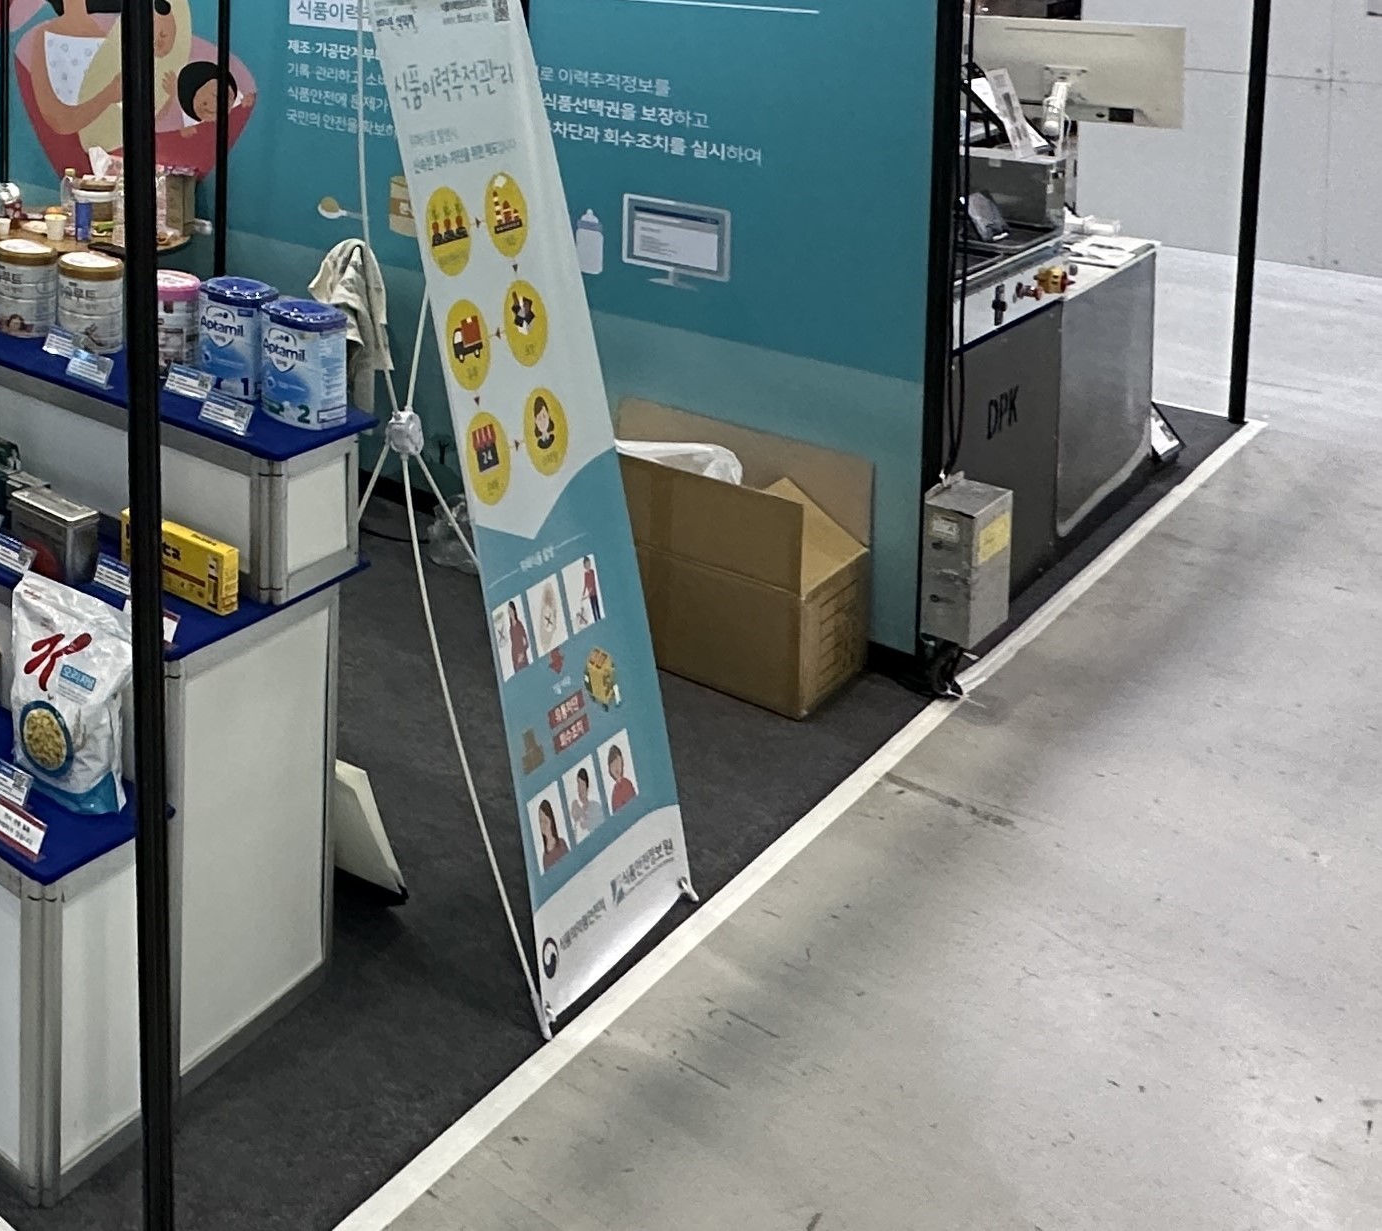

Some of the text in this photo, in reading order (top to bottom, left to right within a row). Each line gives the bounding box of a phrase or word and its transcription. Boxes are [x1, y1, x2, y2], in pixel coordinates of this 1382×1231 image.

[558, 67, 671, 98] 이력추적정보를
[286, 108, 321, 128] 국민의
[542, 92, 711, 130] 식품선택권을 보장하고
[546, 118, 762, 166] 차단과 회수조치를 실시하여
[201, 315, 244, 338] Aptamil
[263, 337, 306, 362] Aptamil
[241, 378, 249, 397] 1
[298, 404, 311, 424] 2
[985, 385, 1020, 442] DPK
[24, 632, 92, 691] K
